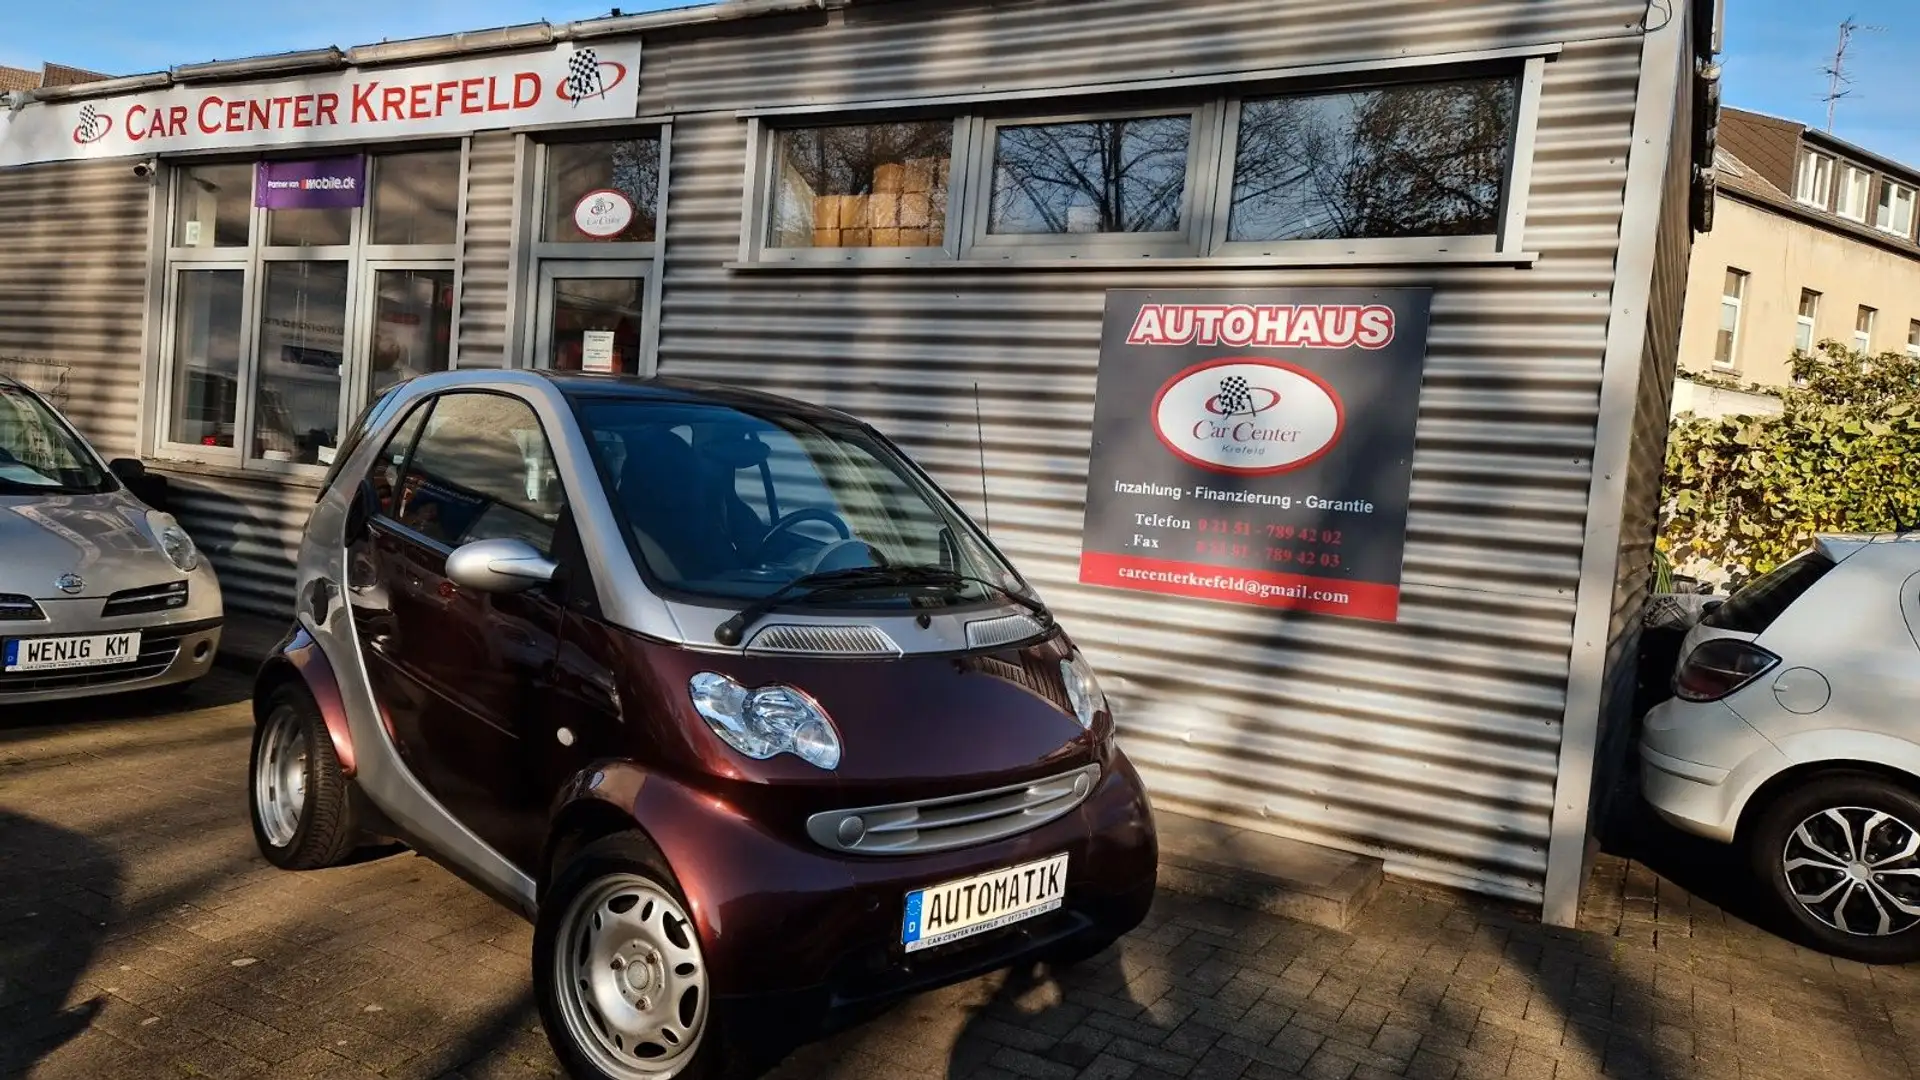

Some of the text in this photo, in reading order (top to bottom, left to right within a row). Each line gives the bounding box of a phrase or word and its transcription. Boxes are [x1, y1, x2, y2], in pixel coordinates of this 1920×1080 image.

[1126, 304, 1396, 350] AUTOHAUS
[1192, 419, 1301, 442] Car Center
[1222, 445, 1265, 455] Krefeld
[1114, 480, 1182, 499] Inzahlung
[1195, 486, 1291, 509] Finanzierung
[1305, 495, 1374, 514] Garantie
[1133, 533, 1160, 549] Fax
[1134, 513, 1191, 530] Telefon
[1266, 524, 1294, 540] 789
[1298, 528, 1317, 542] 42
[1322, 529, 1342, 545] 02
[1118, 565, 1349, 604] carcenterkrefeld@gmail.com
[27, 636, 129, 662] WENIG KM
[927, 861, 1062, 931] AUTOMATIK
[908, 922, 916, 933] D
